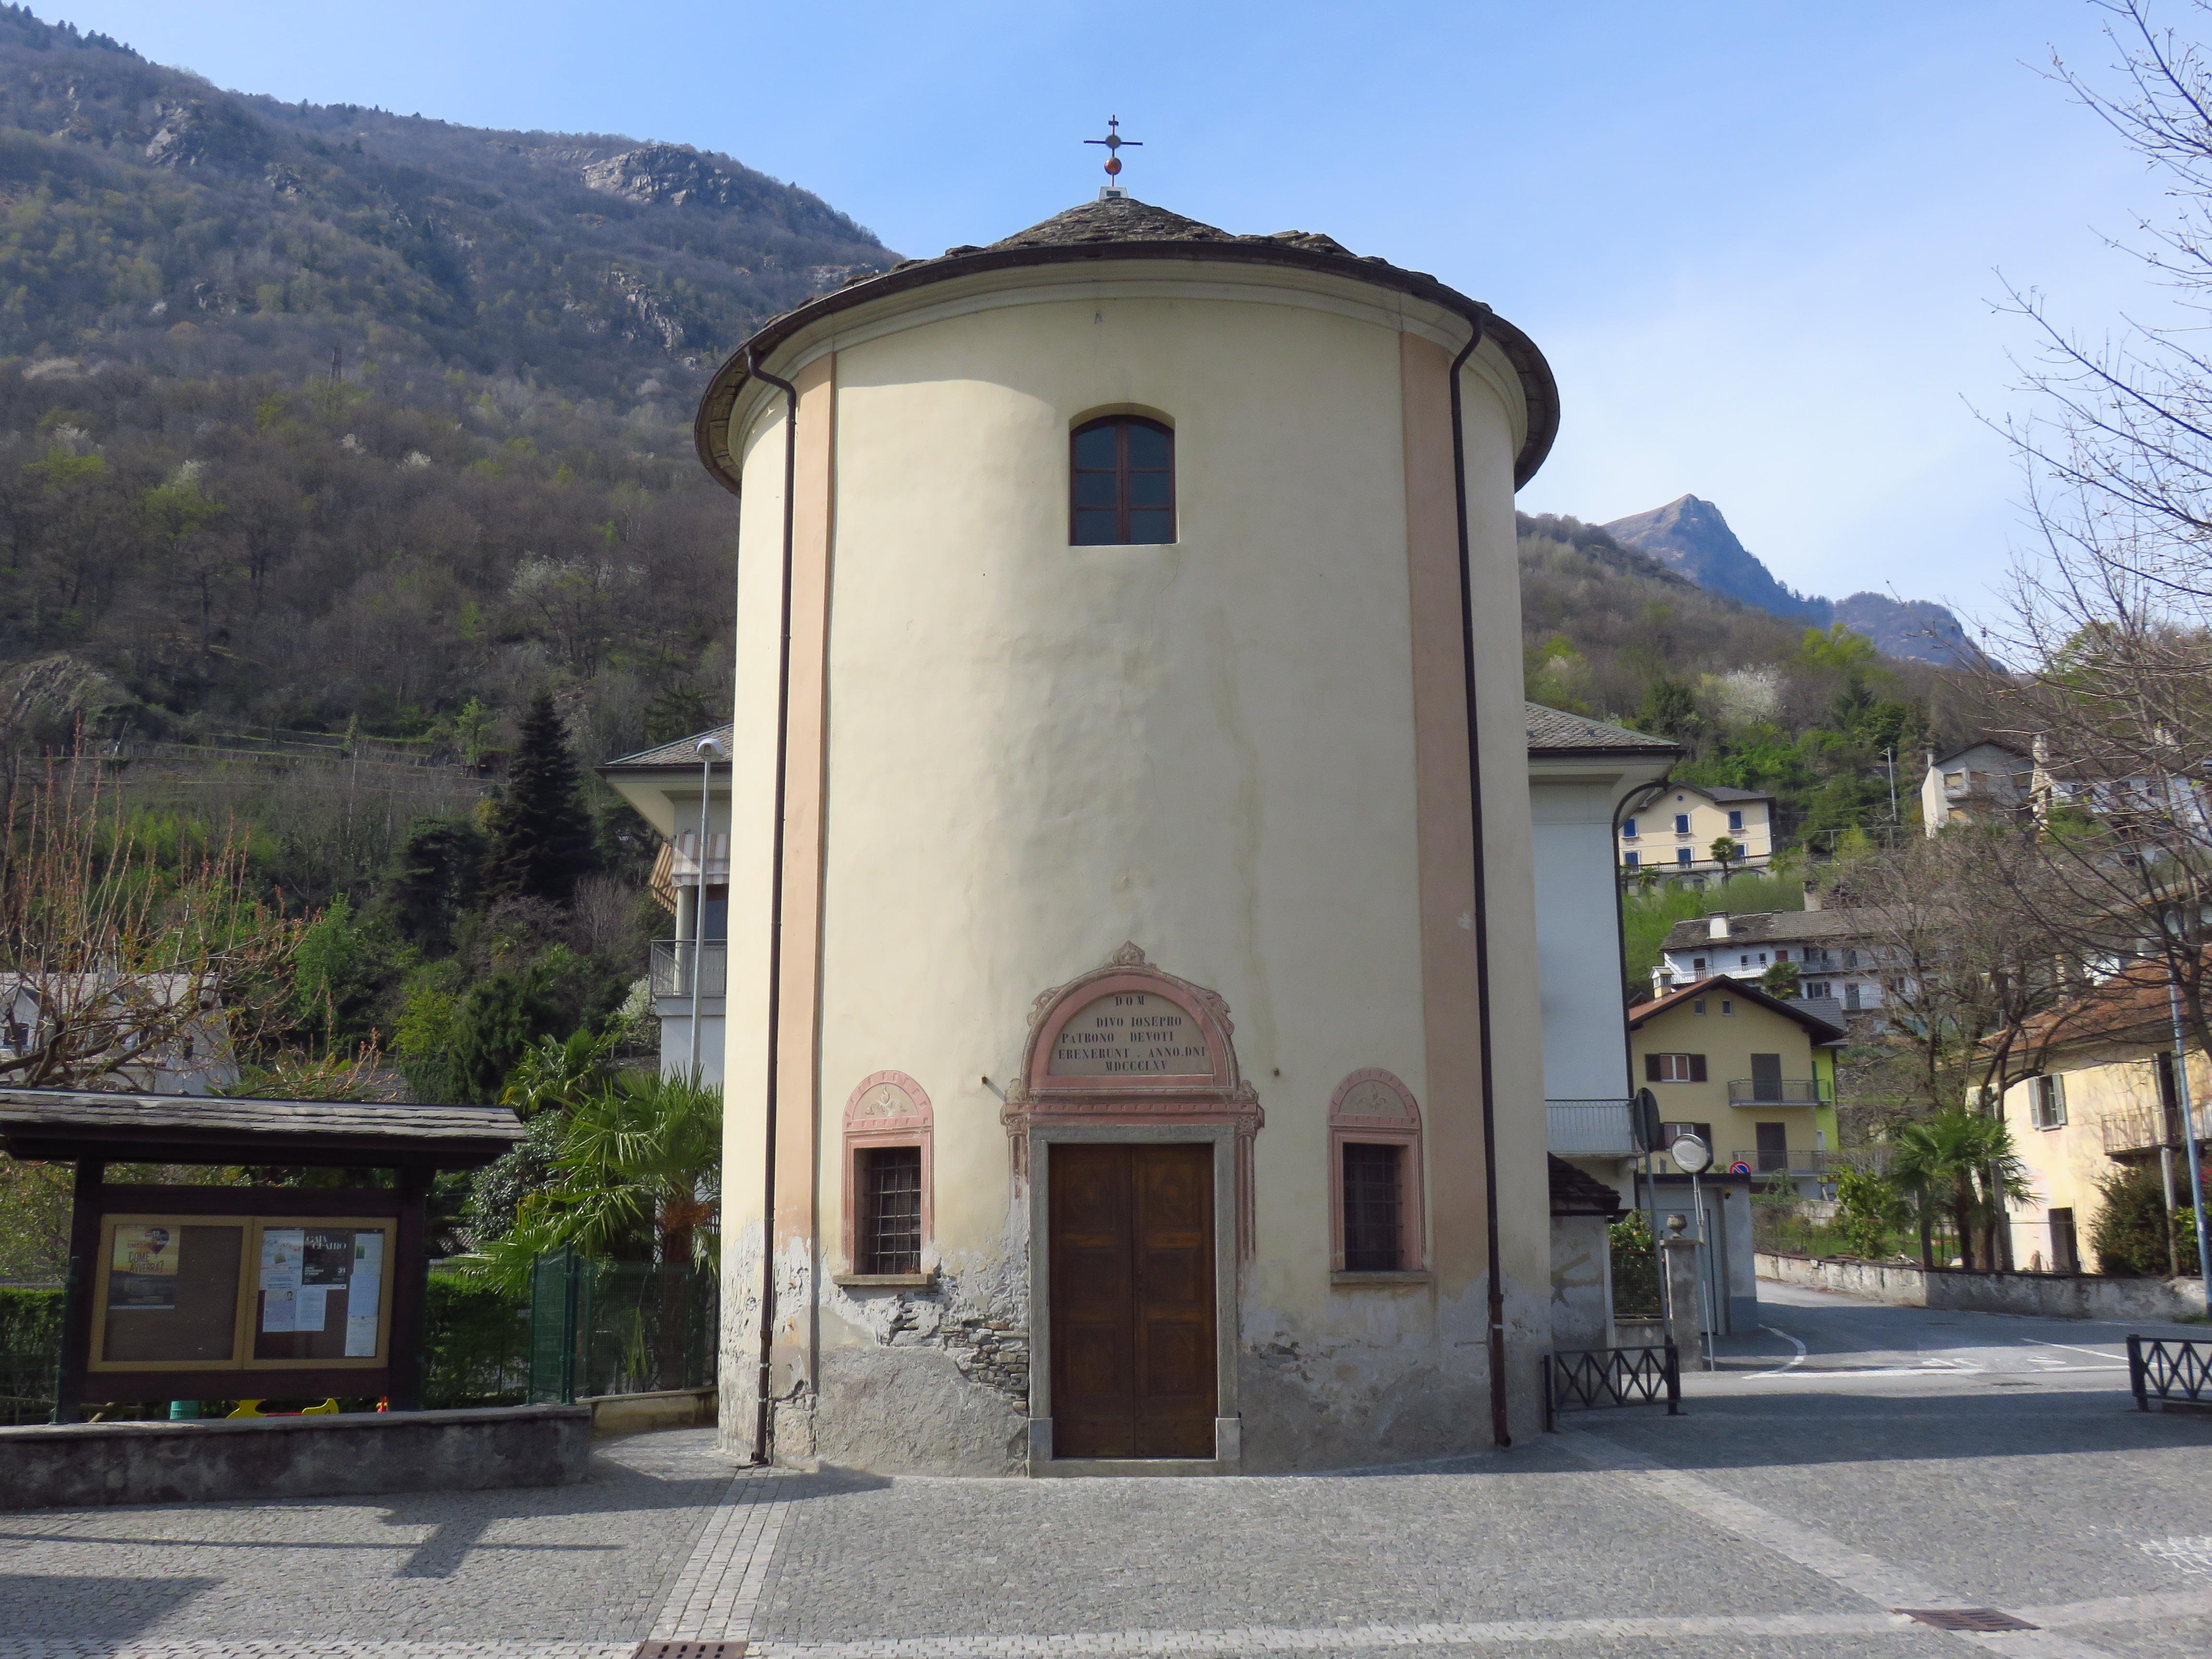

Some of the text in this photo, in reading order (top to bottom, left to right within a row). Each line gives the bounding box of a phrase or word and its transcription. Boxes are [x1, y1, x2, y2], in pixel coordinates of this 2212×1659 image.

[1096, 1016, 1182, 1027] DIVO IOSEPHO
[1061, 1031, 1174, 1044] PATRONO DEVOTI
[1058, 1048, 1130, 1059] EREXERUNT
[1106, 1060, 1167, 1071] MDCCCLXV
